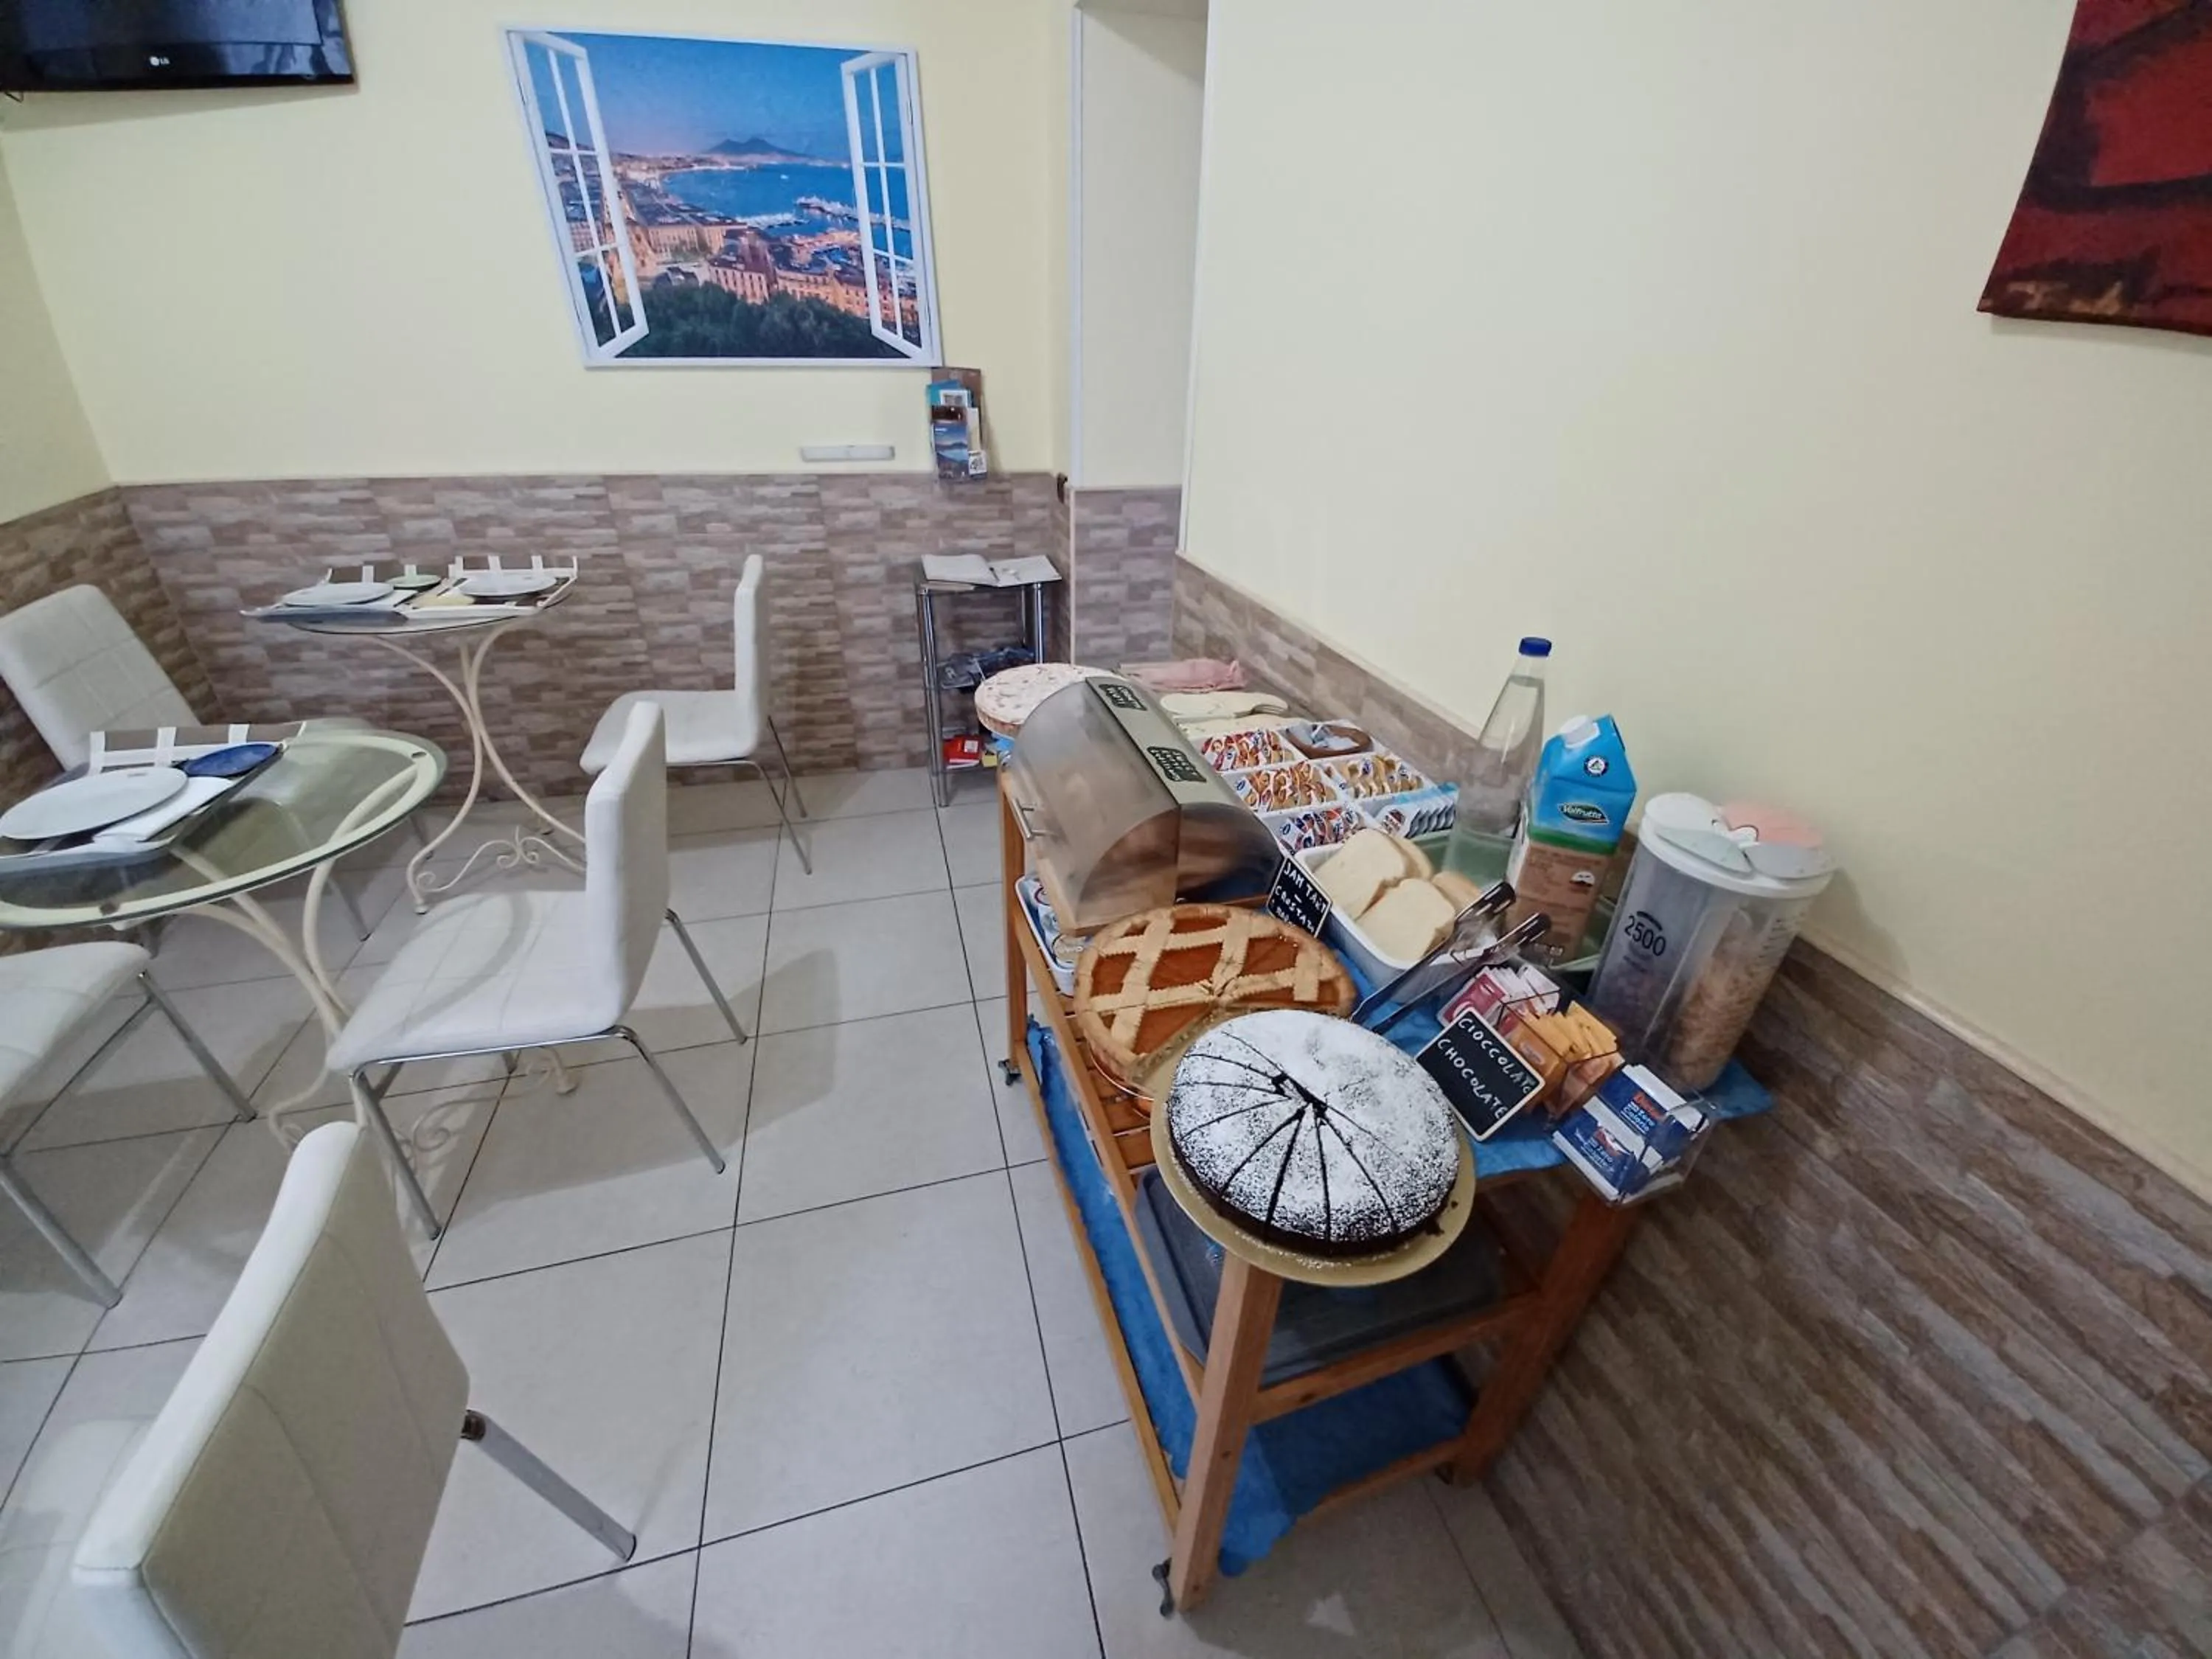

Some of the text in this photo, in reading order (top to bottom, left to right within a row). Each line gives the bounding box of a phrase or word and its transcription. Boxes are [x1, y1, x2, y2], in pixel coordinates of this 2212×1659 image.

[1562, 804, 1602, 820] Valfrutta
[1284, 862, 1326, 914] JAM TART
[1624, 915, 1666, 956] 2500
[1438, 1039, 1509, 1119] CHOCOLATE
[1458, 1018, 1536, 1094] CIOCCOLATO
